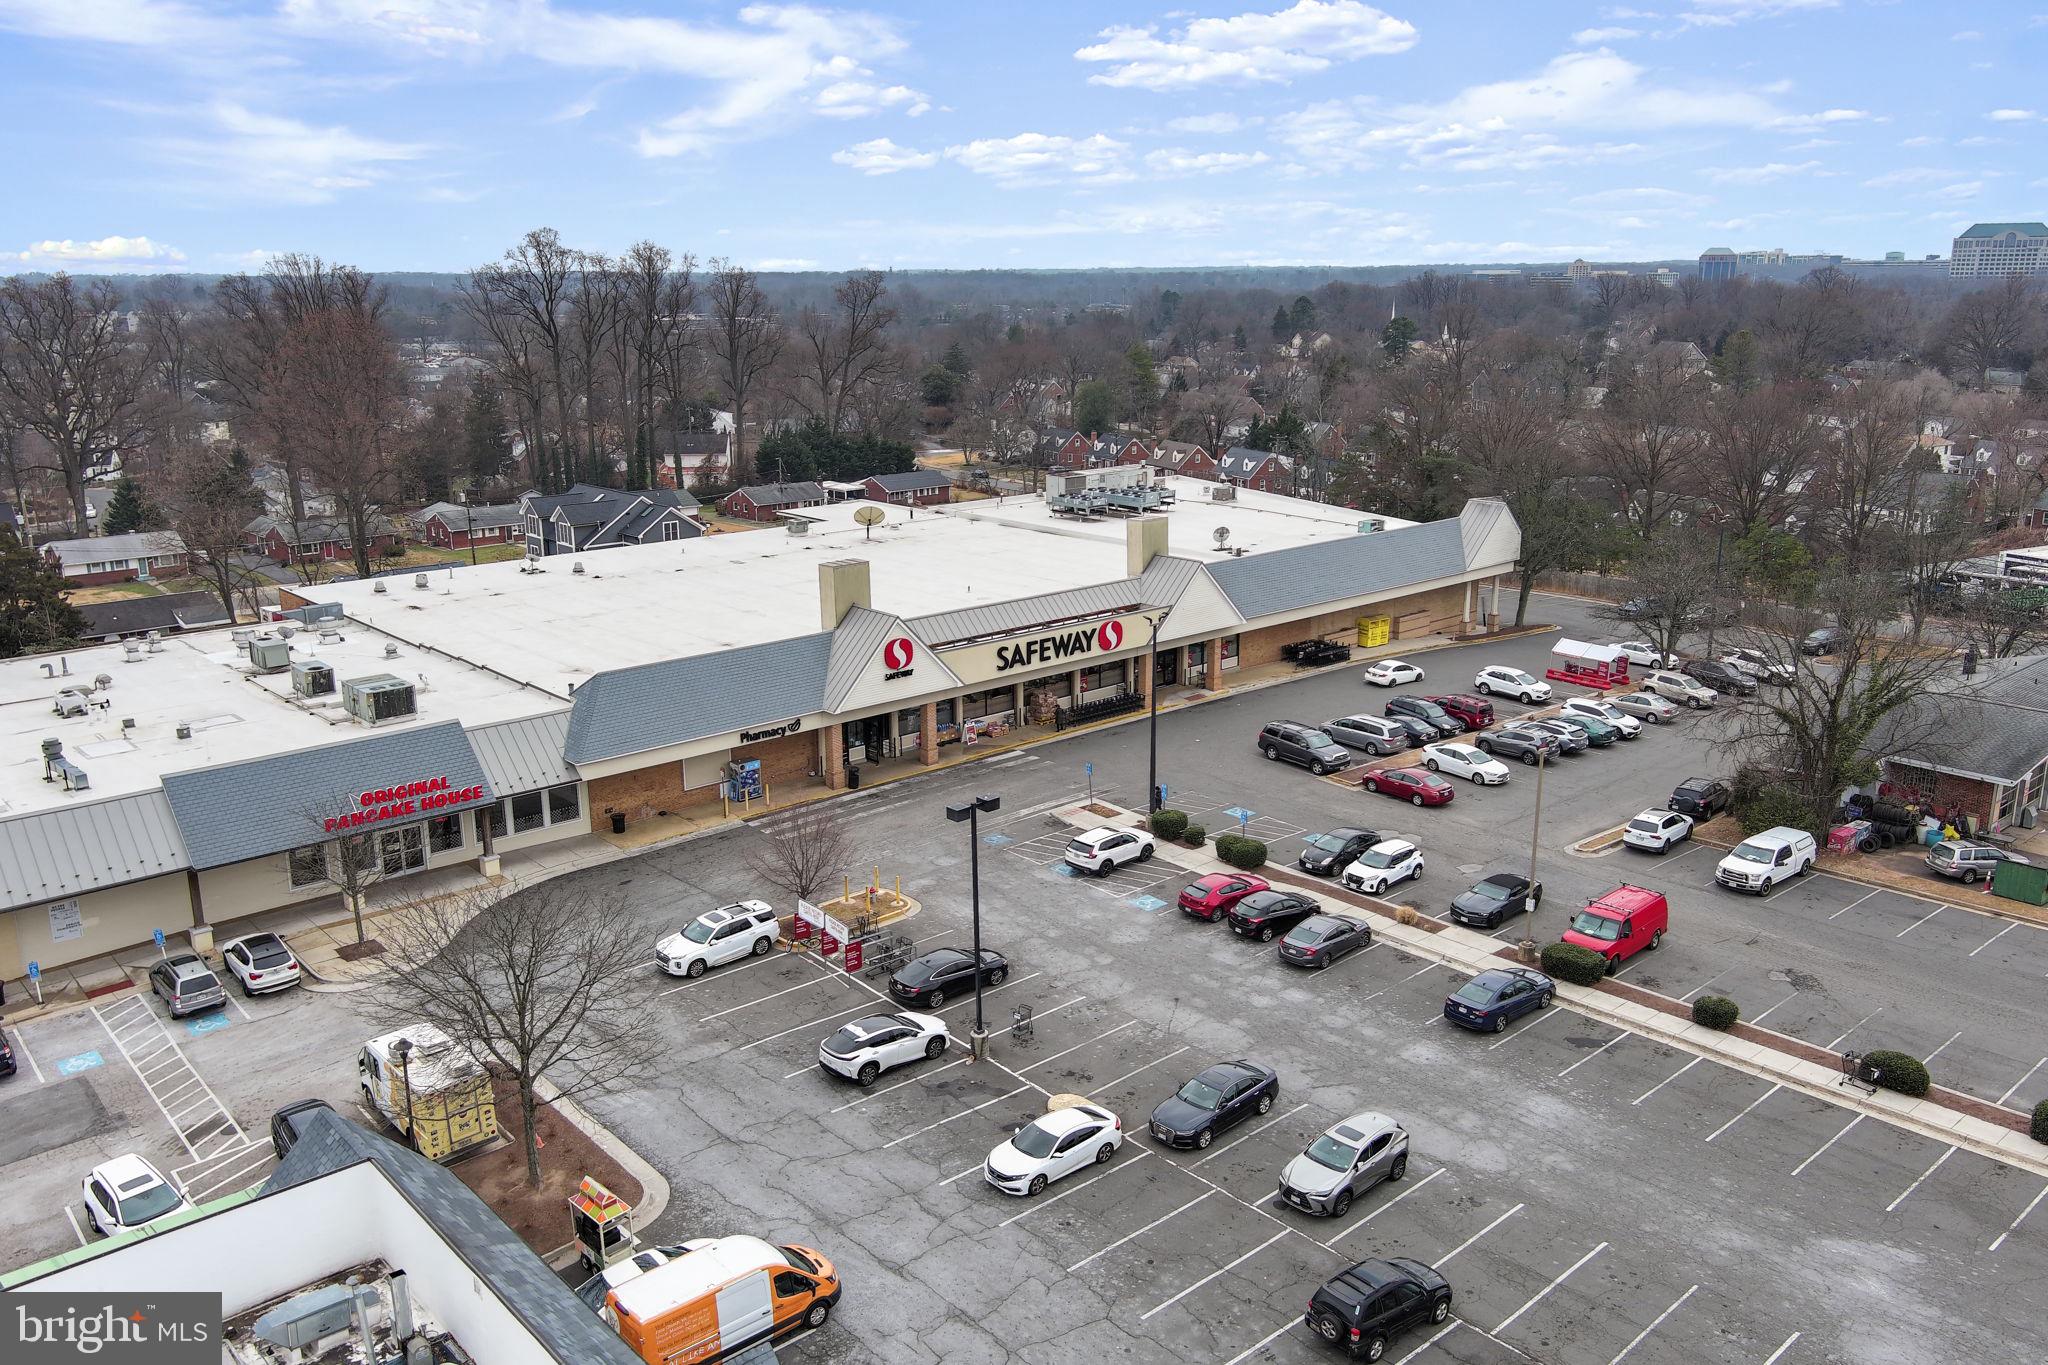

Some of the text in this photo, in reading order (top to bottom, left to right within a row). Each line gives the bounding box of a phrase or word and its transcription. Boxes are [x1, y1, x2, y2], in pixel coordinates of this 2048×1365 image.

[997, 628, 1097, 671] SAFEWAY
[740, 726, 786, 743] Pharmacy
[323, 784, 484, 832] PANCAKE HOUSE
[360, 775, 450, 807] ORIGINAL
